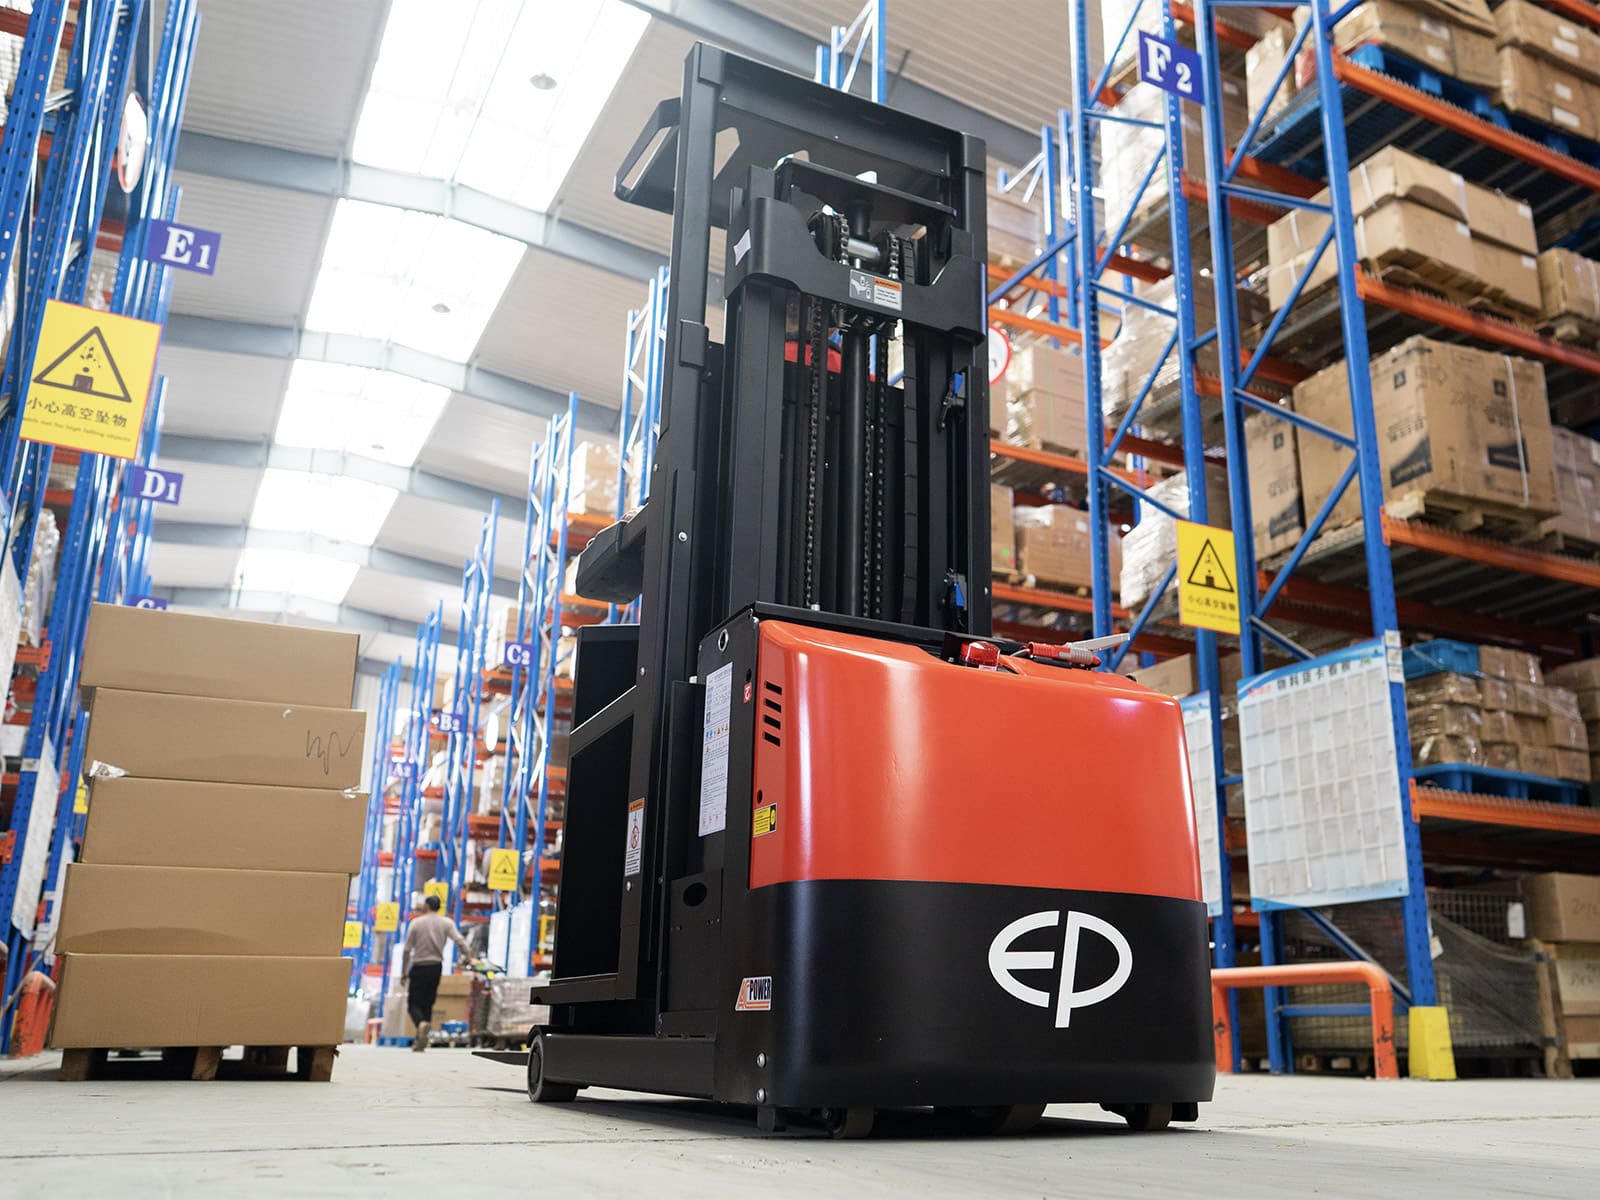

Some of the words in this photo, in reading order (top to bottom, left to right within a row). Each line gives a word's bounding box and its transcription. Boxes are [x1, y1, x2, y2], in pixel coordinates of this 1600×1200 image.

[160, 226, 211, 269] E1
[27, 397, 128, 428] 小心高空坠物
[140, 470, 177, 502] D1
[506, 643, 531, 666] C2
[439, 713, 461, 732] B2
[392, 762, 412, 778] A2
[988, 910, 1133, 1028] EP
[749, 978, 771, 1001] POWER
